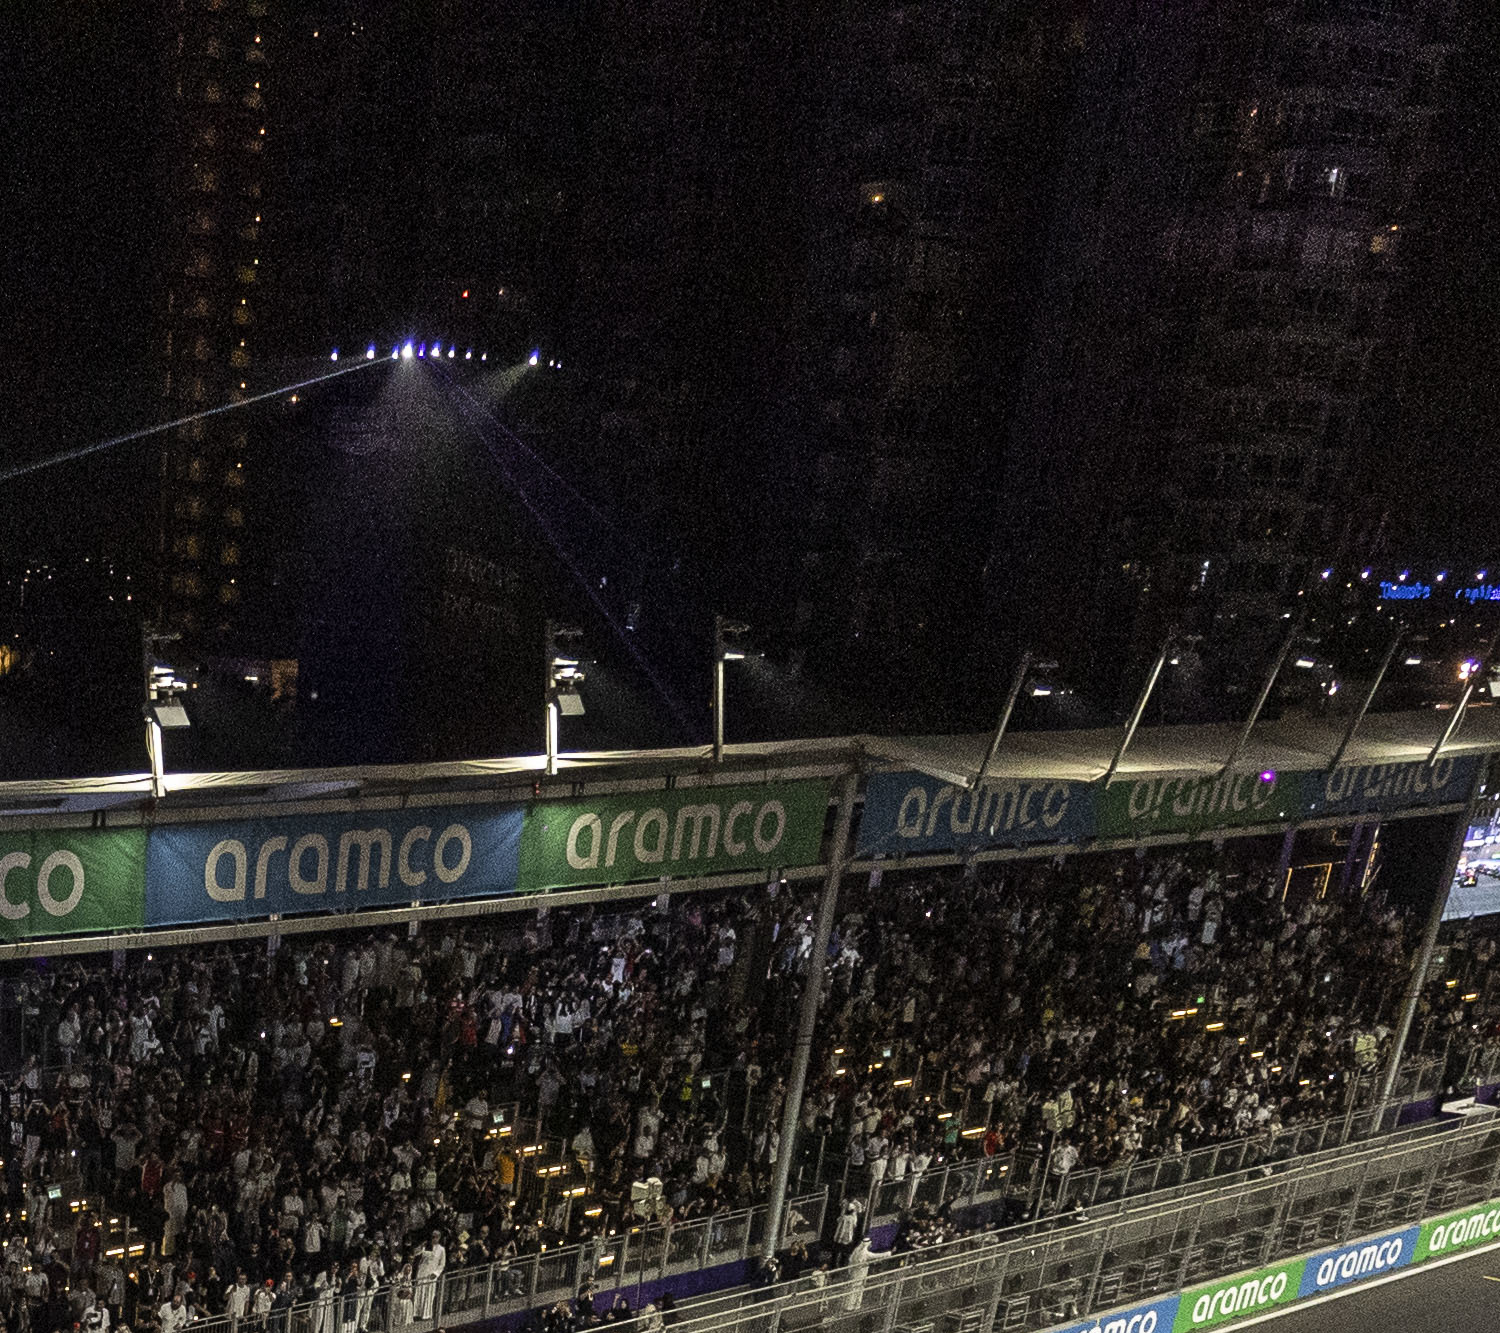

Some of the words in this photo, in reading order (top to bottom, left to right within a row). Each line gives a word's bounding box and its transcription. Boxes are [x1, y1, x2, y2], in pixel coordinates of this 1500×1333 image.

[565, 798, 787, 871] aramco
[900, 782, 1070, 838] aramco
[205, 822, 472, 903] aramco
[1316, 1237, 1402, 1286] aramco
[1193, 1272, 1287, 1323] aramco
